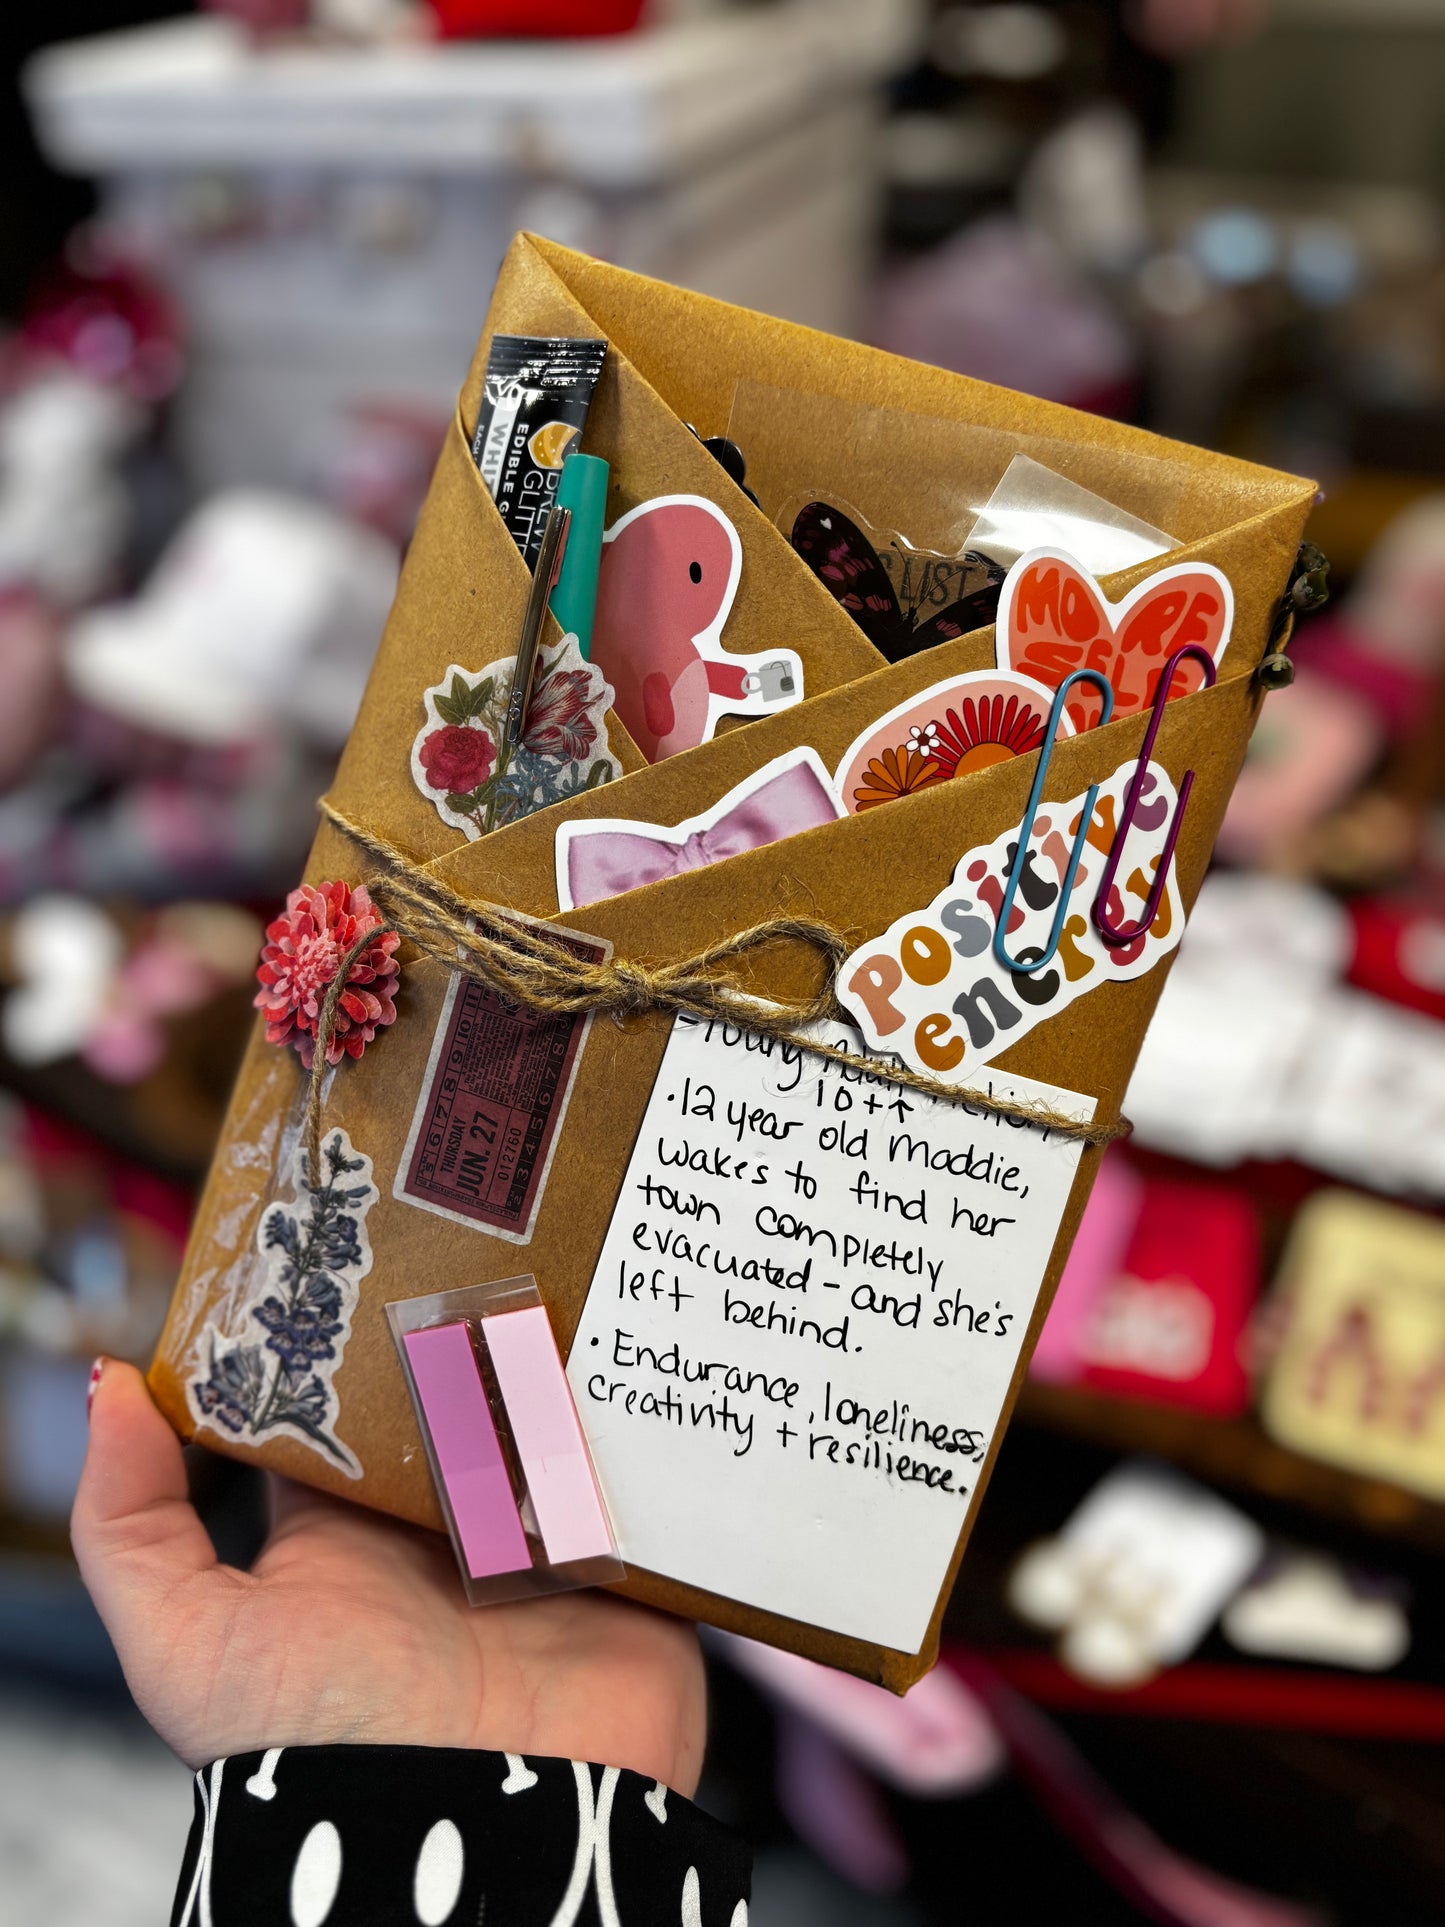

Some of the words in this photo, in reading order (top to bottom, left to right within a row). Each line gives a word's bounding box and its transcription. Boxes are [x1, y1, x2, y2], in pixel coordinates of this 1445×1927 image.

[503, 424, 529, 493] EDIBLE
[429, 1133, 440, 1147] 6
[436, 1104, 448, 1119] 7
[444, 1078, 456, 1092] 8
[452, 1050, 463, 1065] 9
[458, 1020, 471, 1039] 10
[517, 1168, 528, 1181] 3
[525, 1142, 536, 1156] 4
[531, 1117, 543, 1130] 5
[539, 1092, 551, 1105] 6
[545, 1067, 556, 1079] 7
[552, 1043, 564, 1056] 8
[682, 1077, 716, 1121] 12
[728, 1101, 804, 1142] year
[819, 1120, 868, 1160] old
[440, 1116, 466, 1173] THURSDAY
[470, 1111, 498, 1144] 27
[497, 1128, 522, 1180] 012760
[456, 1150, 491, 1196] JUN.
[785, 1161, 817, 1199] to
[850, 1174, 927, 1224] find
[951, 1198, 1016, 1237] her
[637, 1175, 721, 1224] town
[755, 1205, 944, 1292] completely
[618, 1260, 694, 1312] left
[724, 1289, 863, 1353] behind.
[632, 1222, 812, 1291] evacuated
[851, 1283, 921, 1329] and
[933, 1288, 1014, 1337] she's
[587, 1374, 754, 1457] creativity
[808, 1433, 968, 1495] resilience.
